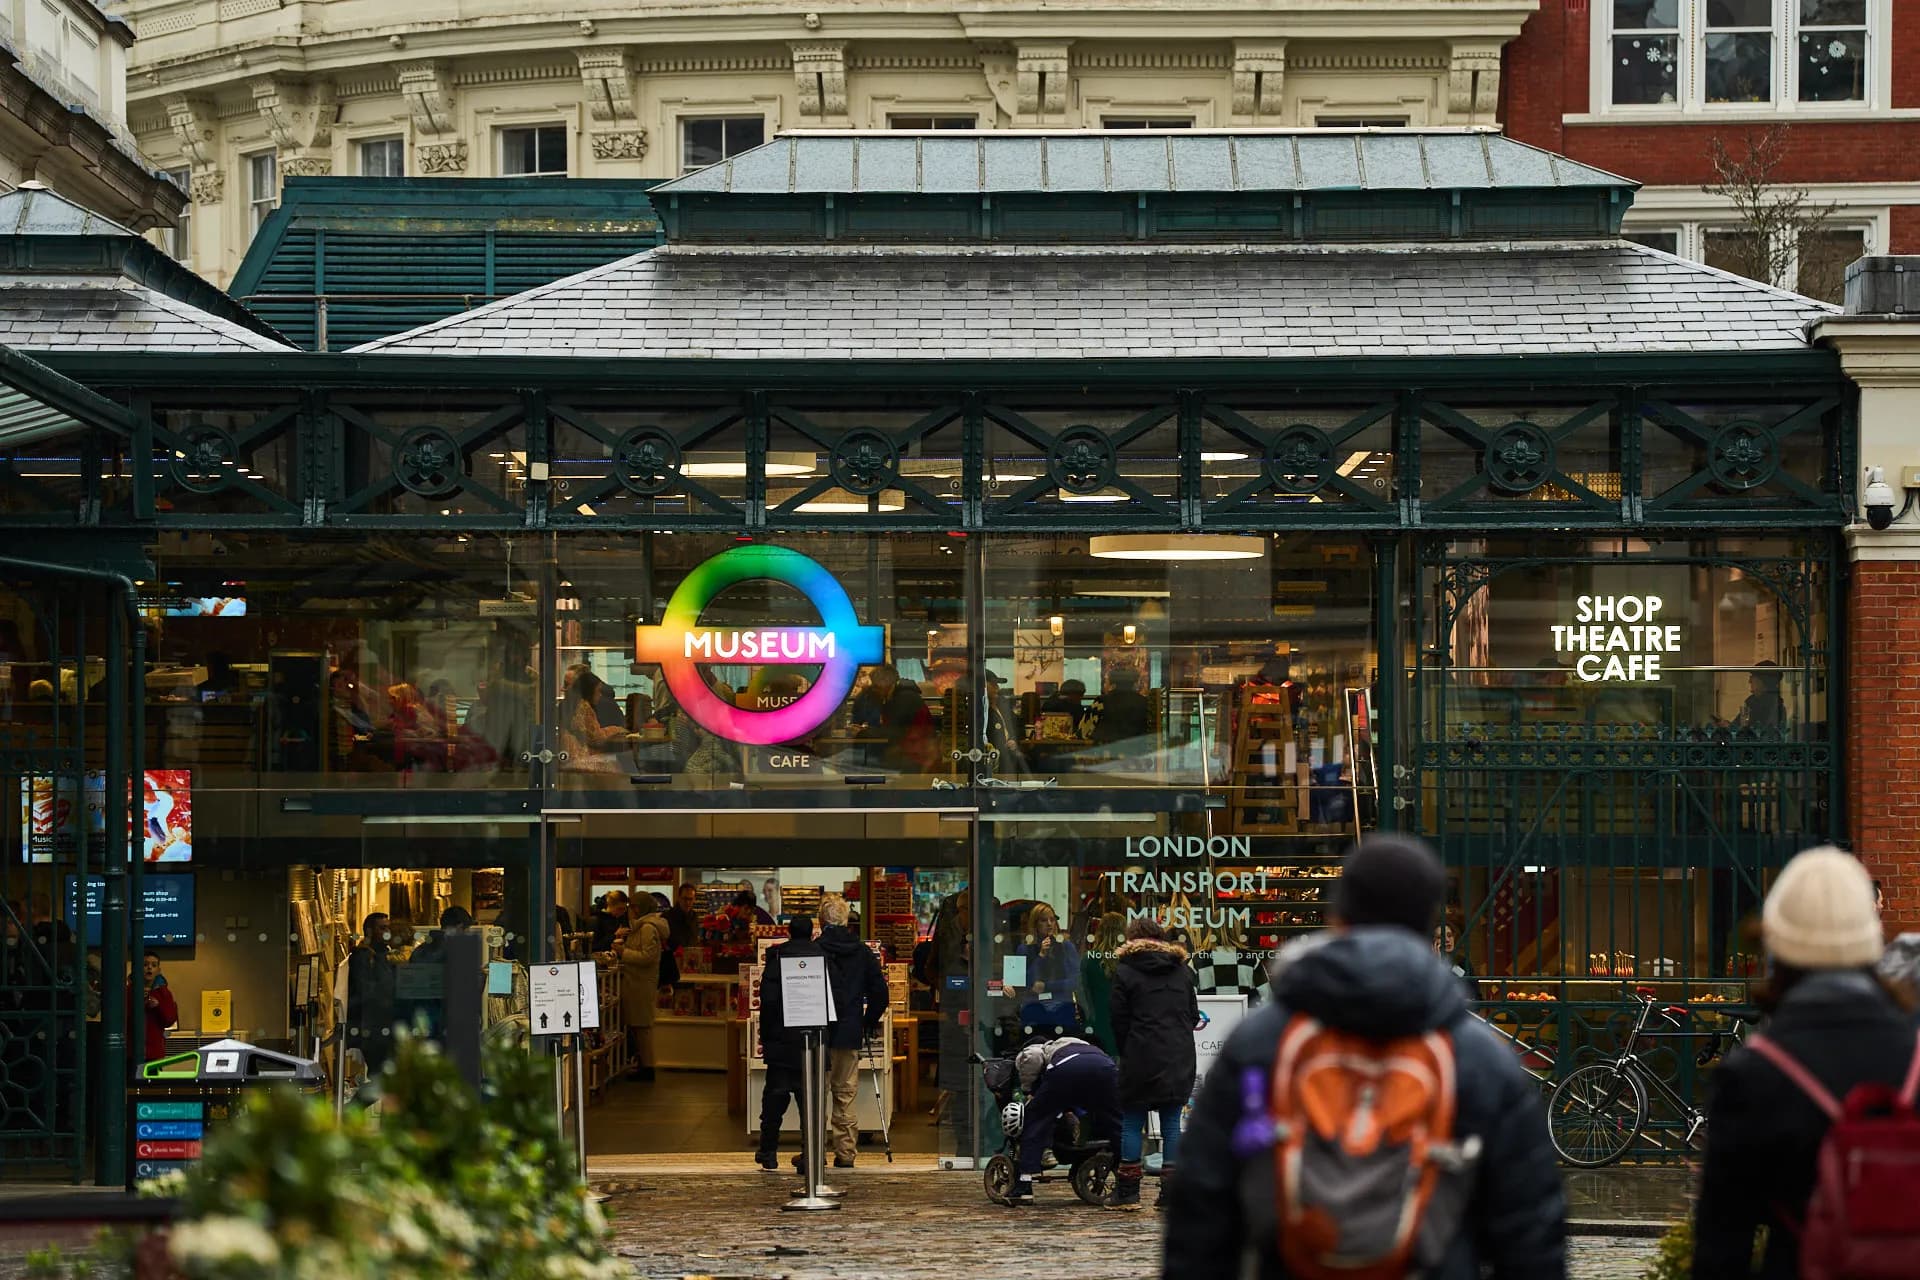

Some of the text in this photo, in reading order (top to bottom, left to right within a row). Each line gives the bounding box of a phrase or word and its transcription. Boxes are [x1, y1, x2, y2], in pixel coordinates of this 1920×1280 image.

[1575, 595, 1663, 623] SHOP
[684, 631, 836, 659] MUSEUM
[1550, 625, 1681, 652] THEATRE
[1576, 654, 1661, 682] CAFE
[769, 755, 810, 768] CAFE
[1125, 835, 1251, 858] LONDON
[1104, 871, 1270, 894] TRANSPORT
[1126, 906, 1251, 929] MUSEUM
[1087, 950, 1102, 960] No
[1246, 950, 1265, 960] and
[1201, 1040, 1225, 1050] CAF
